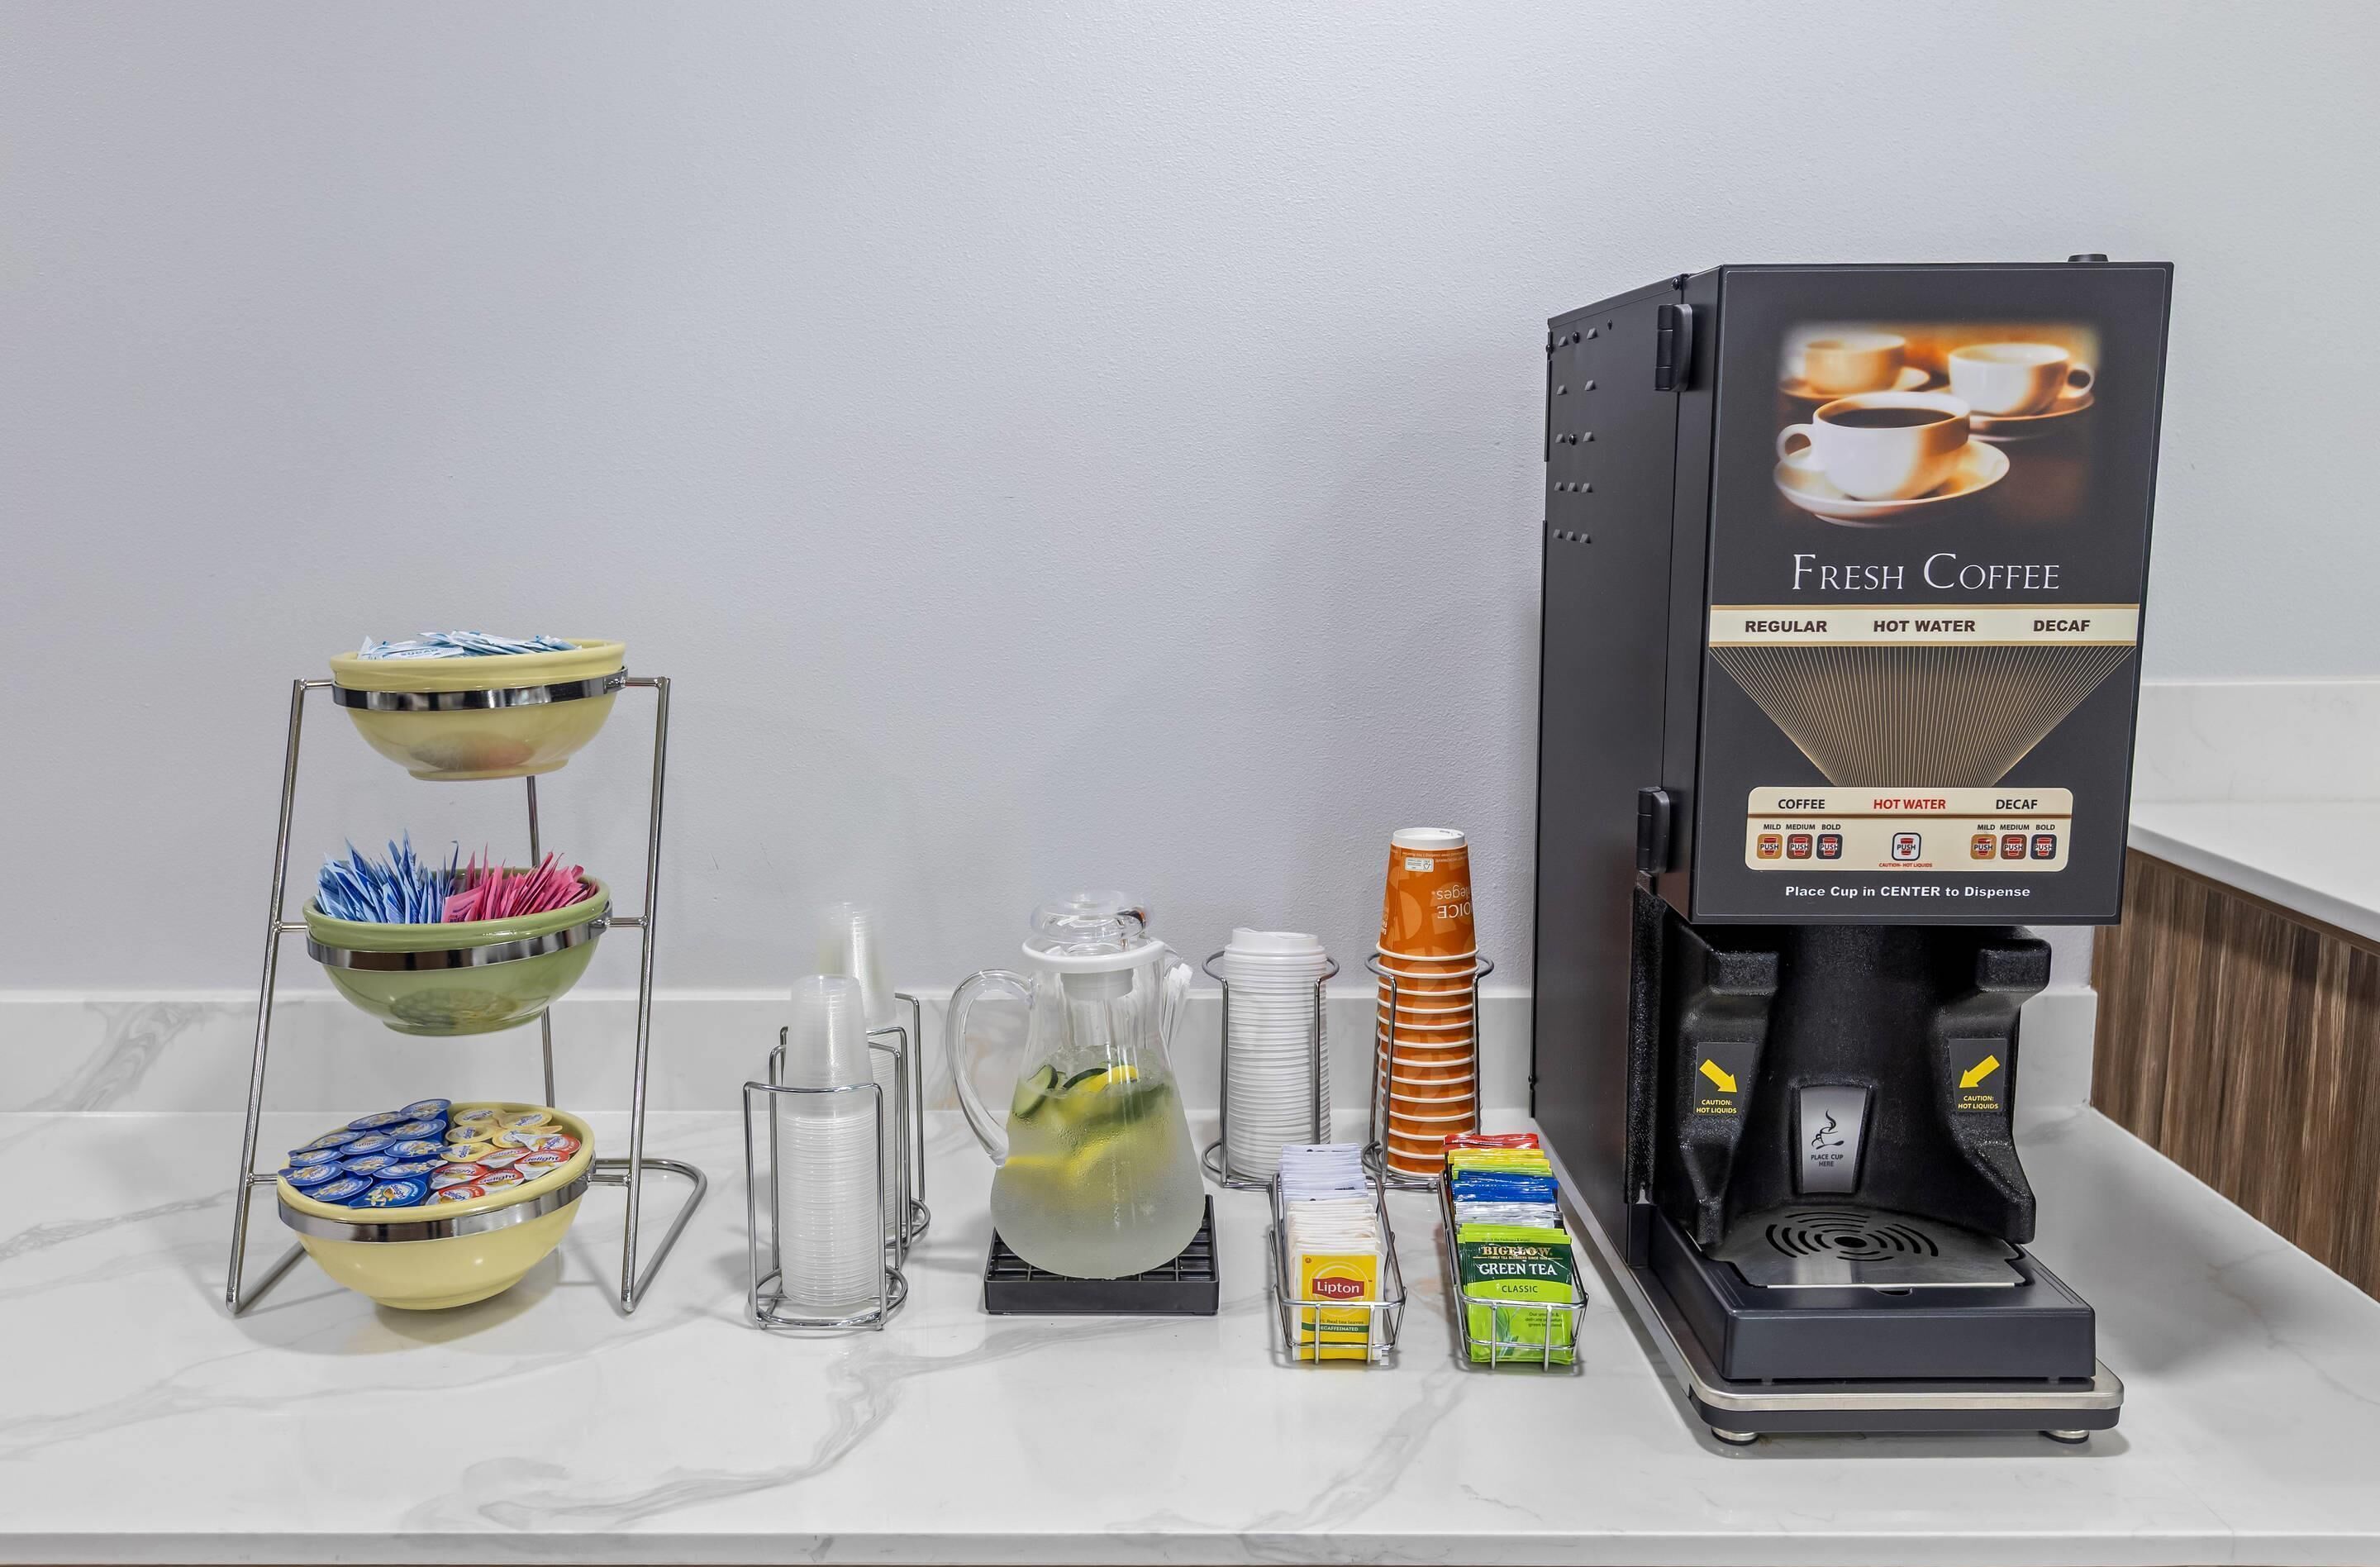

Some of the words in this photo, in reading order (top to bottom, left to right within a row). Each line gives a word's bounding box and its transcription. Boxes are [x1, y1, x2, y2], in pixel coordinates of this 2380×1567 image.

[1745, 620, 1828, 633] REGULAR
[1873, 620, 1910, 633] HOT
[1914, 620, 1976, 633] WATER
[2033, 619, 2091, 632] DECAF
[1778, 799, 1825, 810] COFFEE
[1873, 799, 1901, 810] HOT
[1903, 799, 1946, 810] WATER
[1996, 799, 2038, 810] DECAF
[1785, 886, 1825, 897] Place
[1830, 886, 1858, 898] Cup
[1863, 886, 1875, 897] in
[1881, 886, 1940, 897] CENTER
[1945, 887, 1959, 897] to
[1964, 886, 2030, 898] Dispense
[478, 1174, 516, 1184] delight
[1482, 1246, 1552, 1256] BIGELOW
[1479, 1263, 1526, 1274] GREEN
[1528, 1264, 1558, 1275] TEA
[1317, 1281, 1359, 1294] Lipton
[1502, 1285, 1538, 1293] CLASSIC
